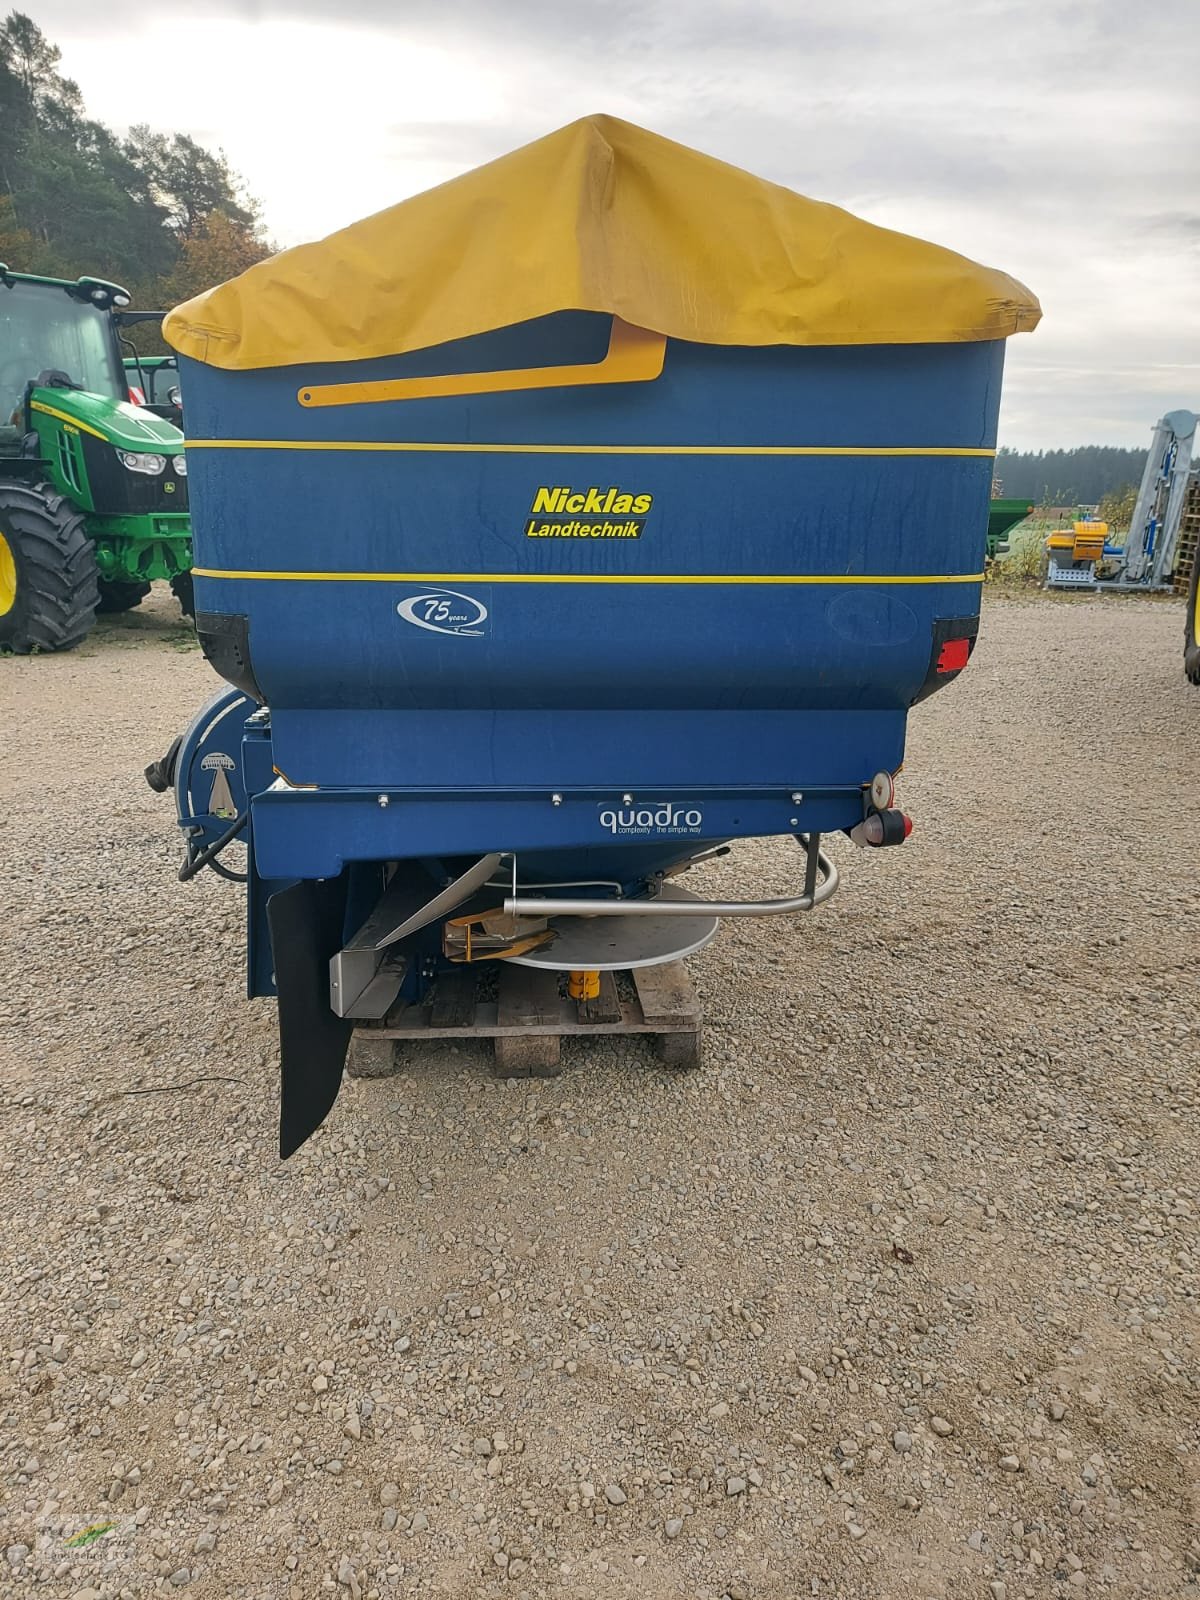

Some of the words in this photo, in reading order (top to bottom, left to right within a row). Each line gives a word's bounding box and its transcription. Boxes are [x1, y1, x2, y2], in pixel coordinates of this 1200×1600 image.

[531, 487, 653, 514] Nicklas
[526, 520, 640, 538] Landtechnik
[424, 600, 452, 621] 75
[448, 615, 468, 623] years
[599, 803, 703, 834] quadro
[618, 826, 651, 835] complexity
[667, 826, 688, 834] simple
